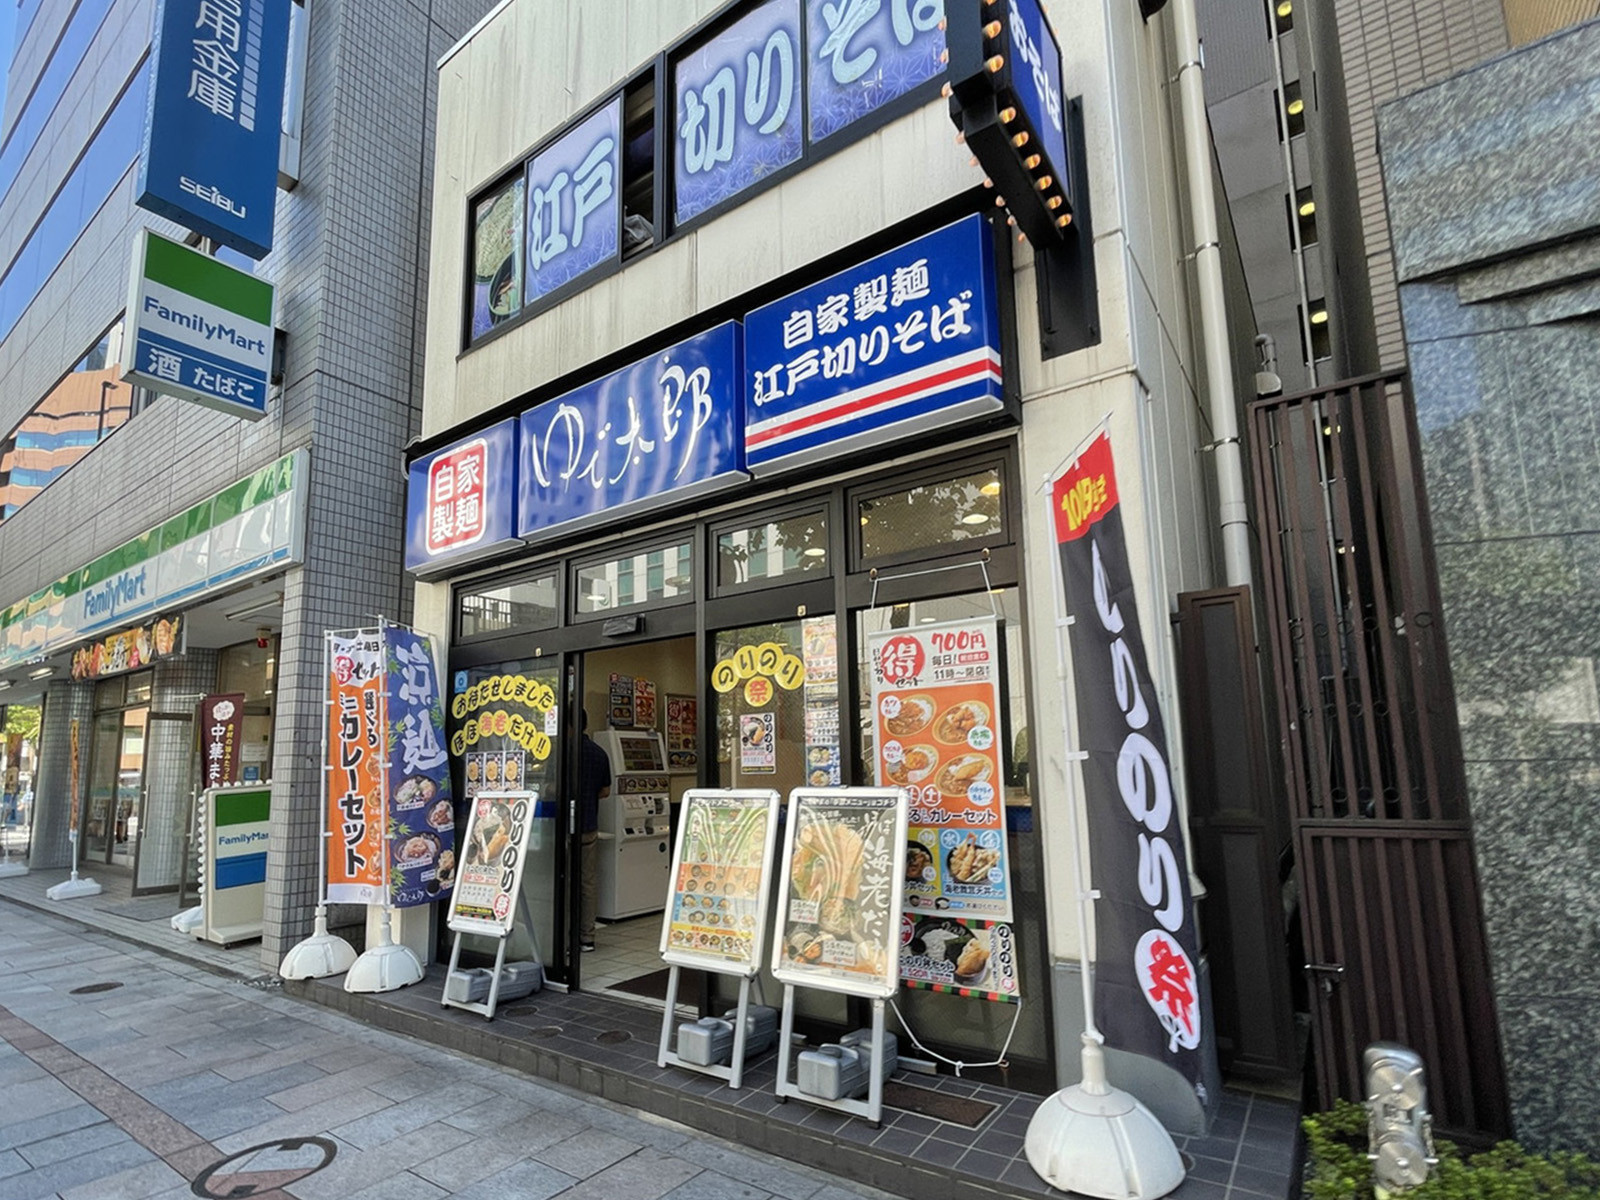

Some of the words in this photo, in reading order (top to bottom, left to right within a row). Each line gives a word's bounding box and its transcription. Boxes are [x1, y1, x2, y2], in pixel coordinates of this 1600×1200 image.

[144, 296, 266, 356] FamilyMart
[783, 258, 931, 349] 自家製麺
[753, 289, 973, 407] 江戸切りそば
[148, 348, 183, 383] 酒
[194, 365, 255, 403] たばこ
[532, 355, 713, 493] ゆで太郎
[83, 565, 147, 619] FamilyMart
[717, 648, 800, 687] のりのり
[883, 642, 918, 677] 得
[931, 630, 986, 653] 700円
[456, 680, 554, 716] お待たせしました
[749, 680, 769, 702] 祭
[208, 722, 227, 783] 中華ま
